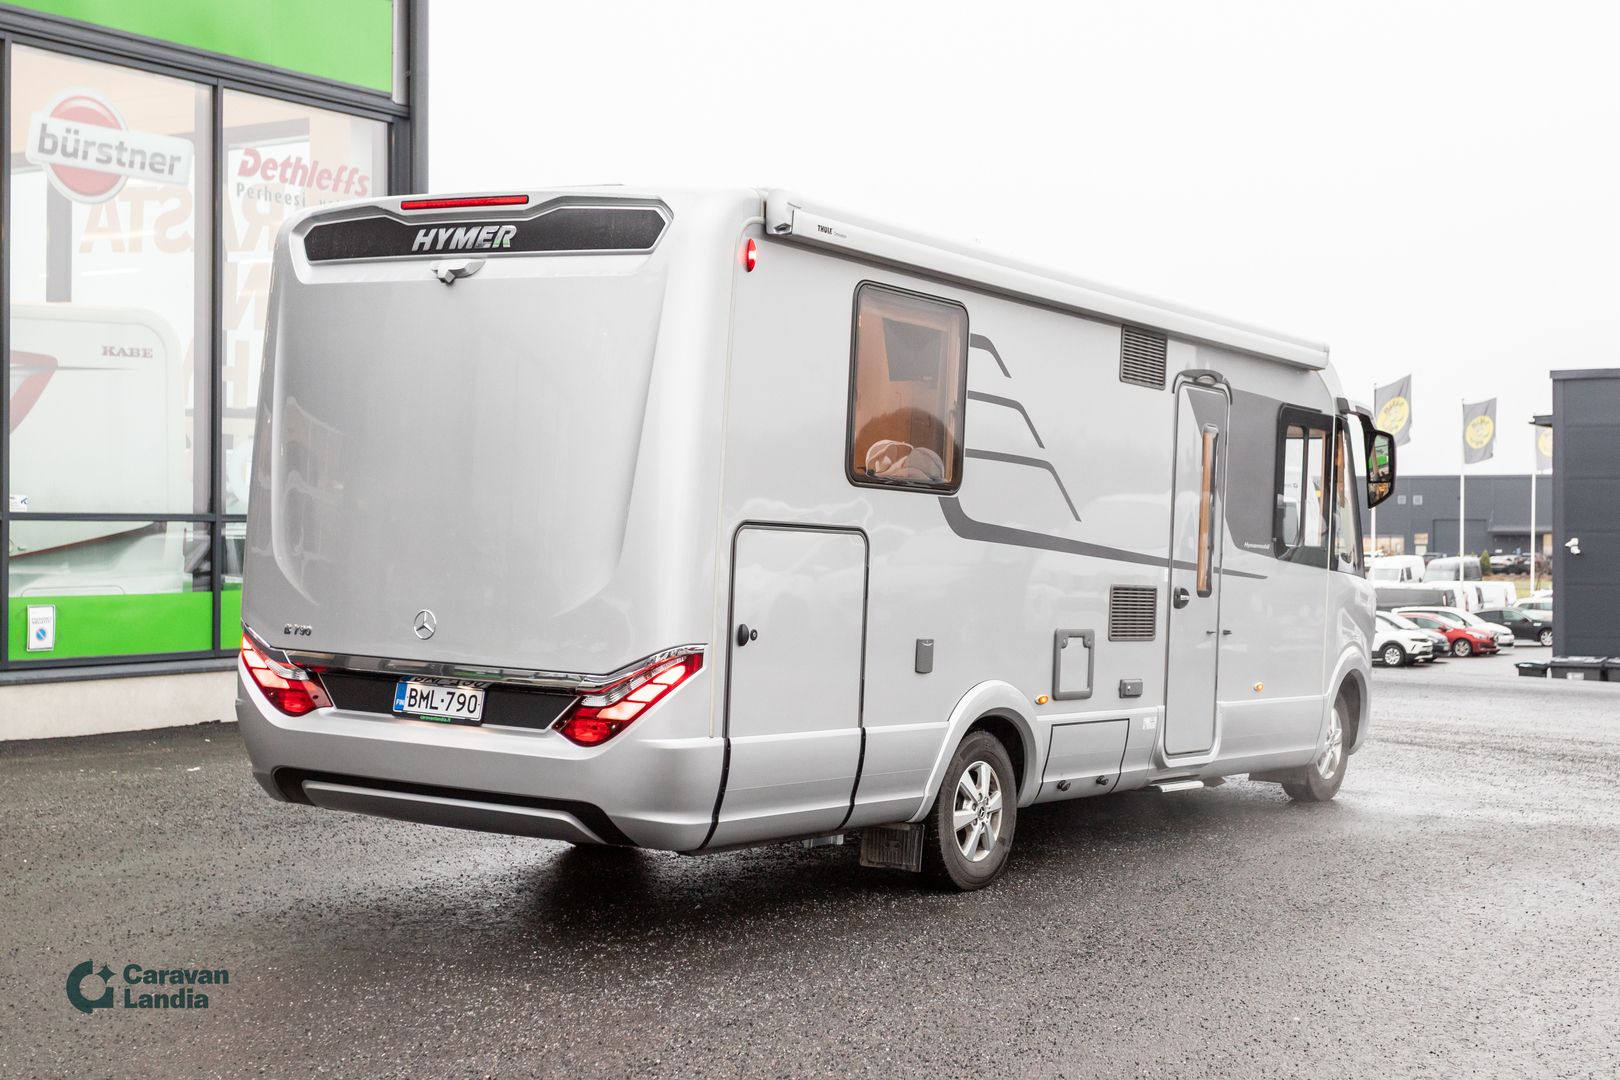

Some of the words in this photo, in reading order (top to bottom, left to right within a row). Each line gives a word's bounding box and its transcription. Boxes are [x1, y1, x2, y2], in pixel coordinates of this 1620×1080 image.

[37, 122, 181, 176] bürstner
[237, 147, 370, 197] Dethleffs
[236, 182, 306, 208] Perheesi
[411, 224, 517, 252] HYMER
[817, 224, 832, 234] THULE
[102, 345, 153, 359] KABE
[407, 688, 478, 714] BML-790
